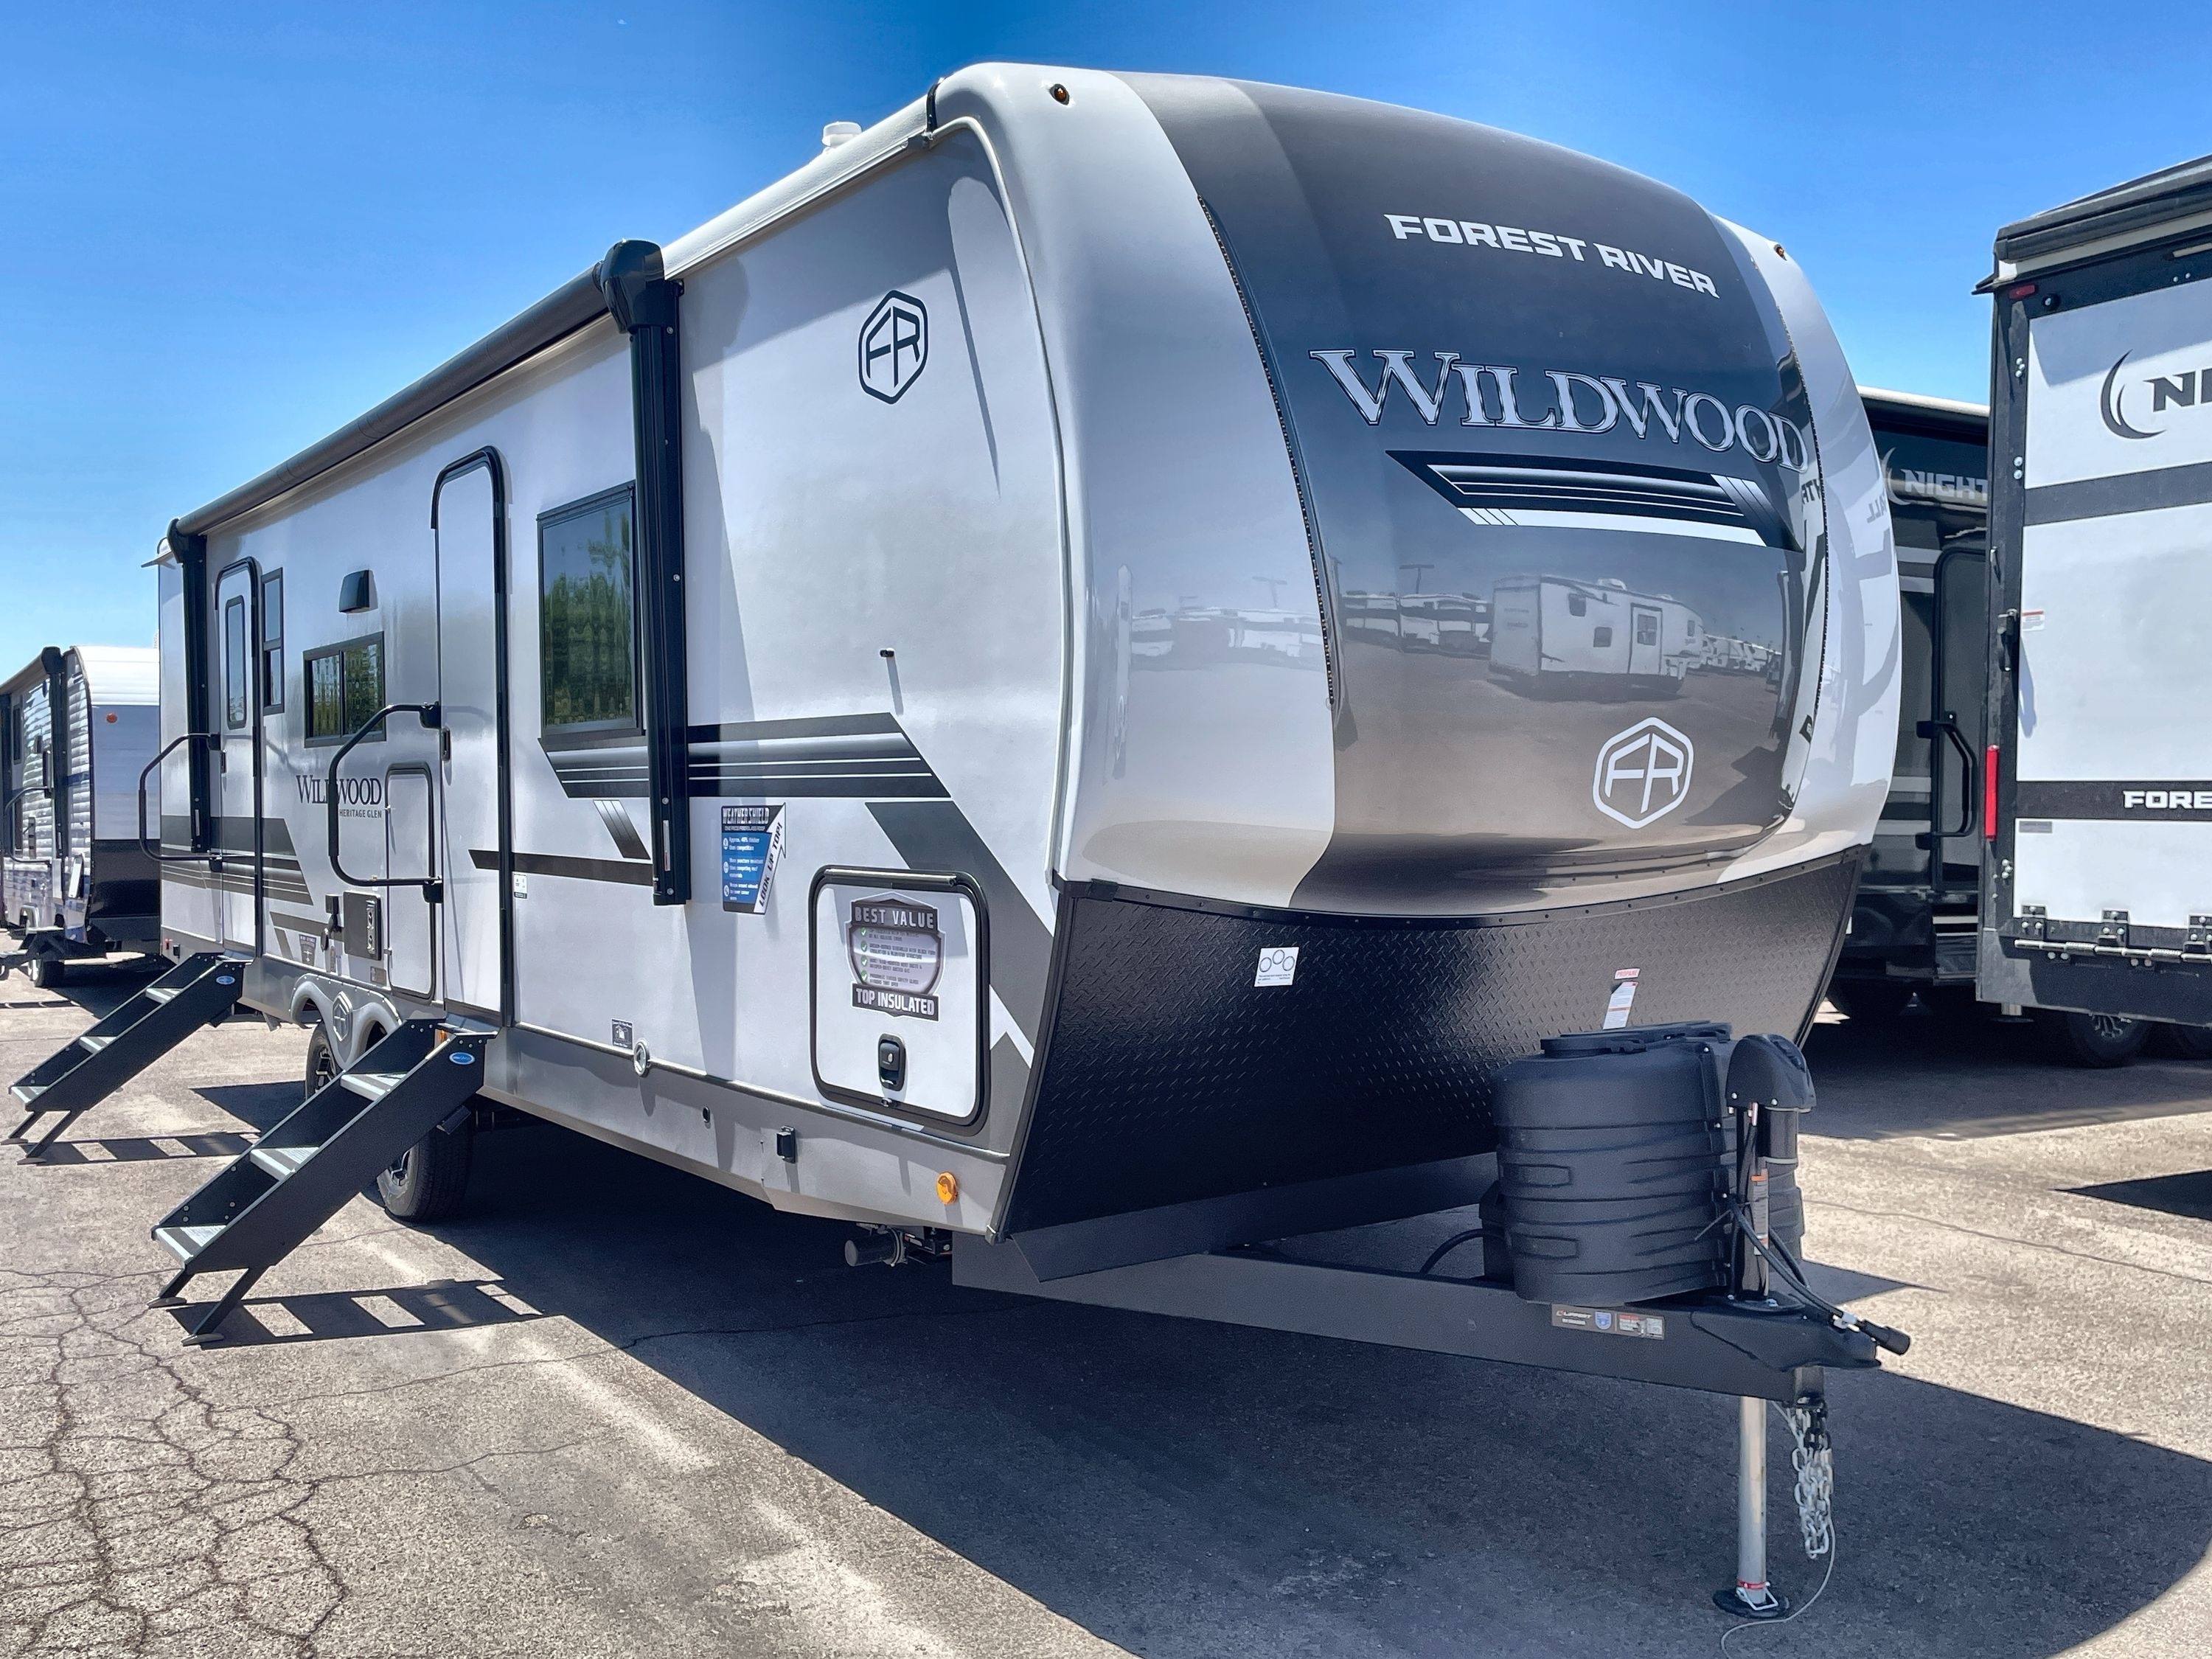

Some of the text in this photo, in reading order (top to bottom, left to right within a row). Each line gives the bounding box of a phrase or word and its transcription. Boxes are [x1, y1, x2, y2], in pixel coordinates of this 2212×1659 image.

[1384, 214, 1720, 299] FOREST RIVER
[1309, 349, 1809, 473] WILDWOOD
[338, 809, 382, 818] HERITAGE GLEN
[759, 876, 771, 907] LOOK
[768, 853, 774, 872] UP
[855, 906, 934, 928] BEST VALUE
[856, 988, 935, 1016] TOP INSULATED
